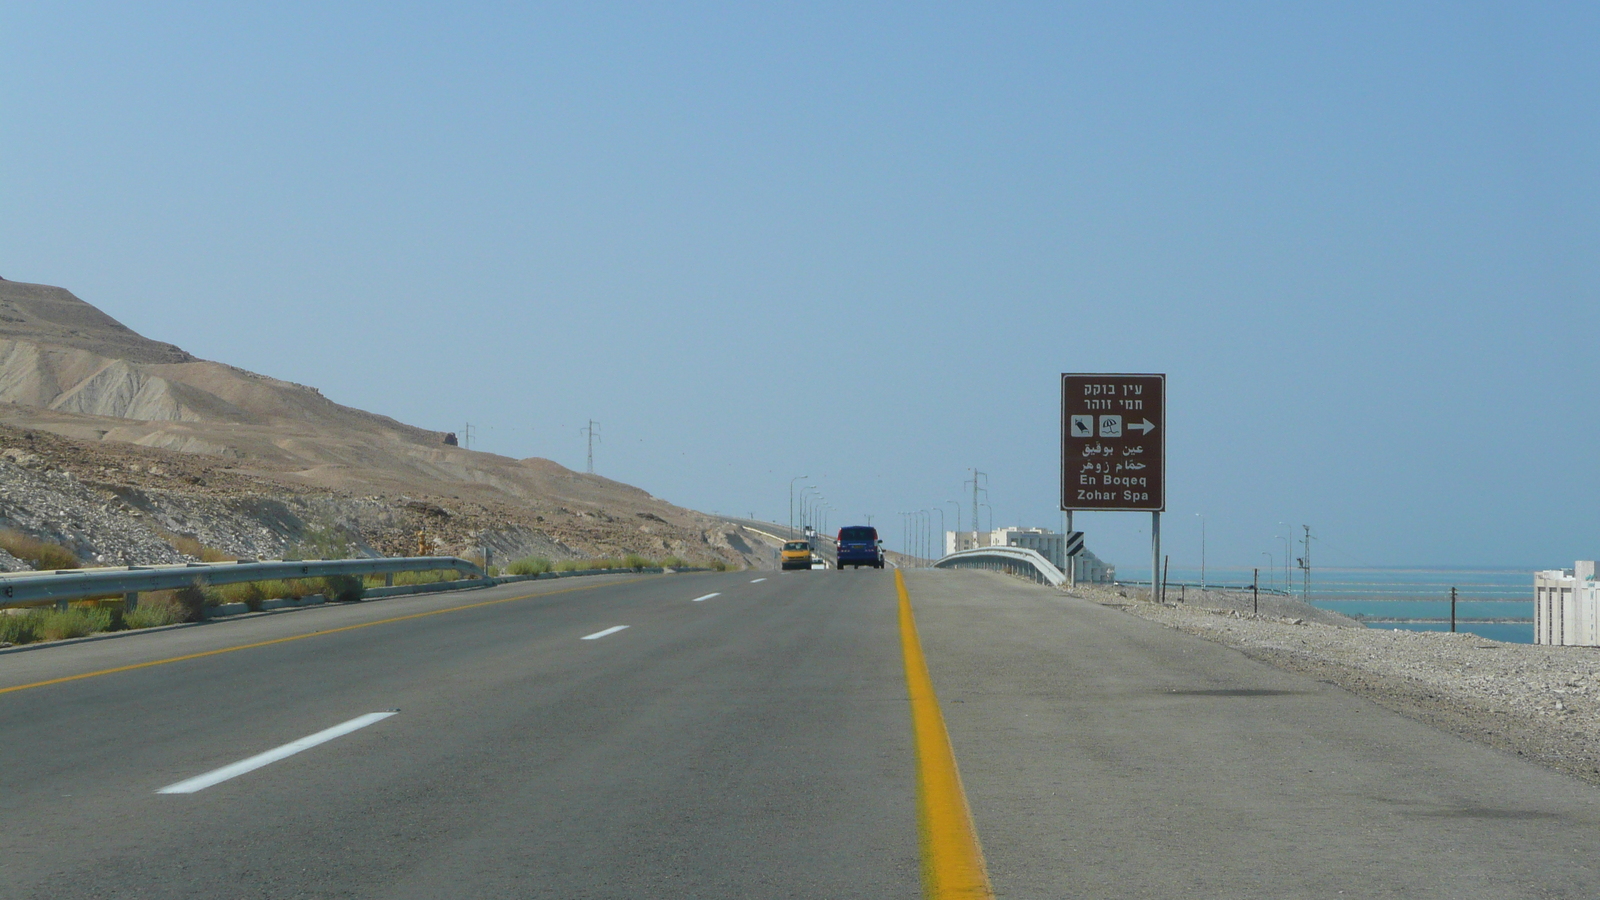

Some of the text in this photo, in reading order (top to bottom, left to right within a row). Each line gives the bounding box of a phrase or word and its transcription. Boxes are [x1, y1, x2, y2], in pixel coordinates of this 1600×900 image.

[1084, 384, 1143, 396] עין בוקק
[1084, 399, 1143, 410] חמי זוהר
[1122, 445, 1143, 457] عين
[1080, 475, 1147, 487] En Boqeq
[1077, 489, 1149, 502] Zohar Spa
